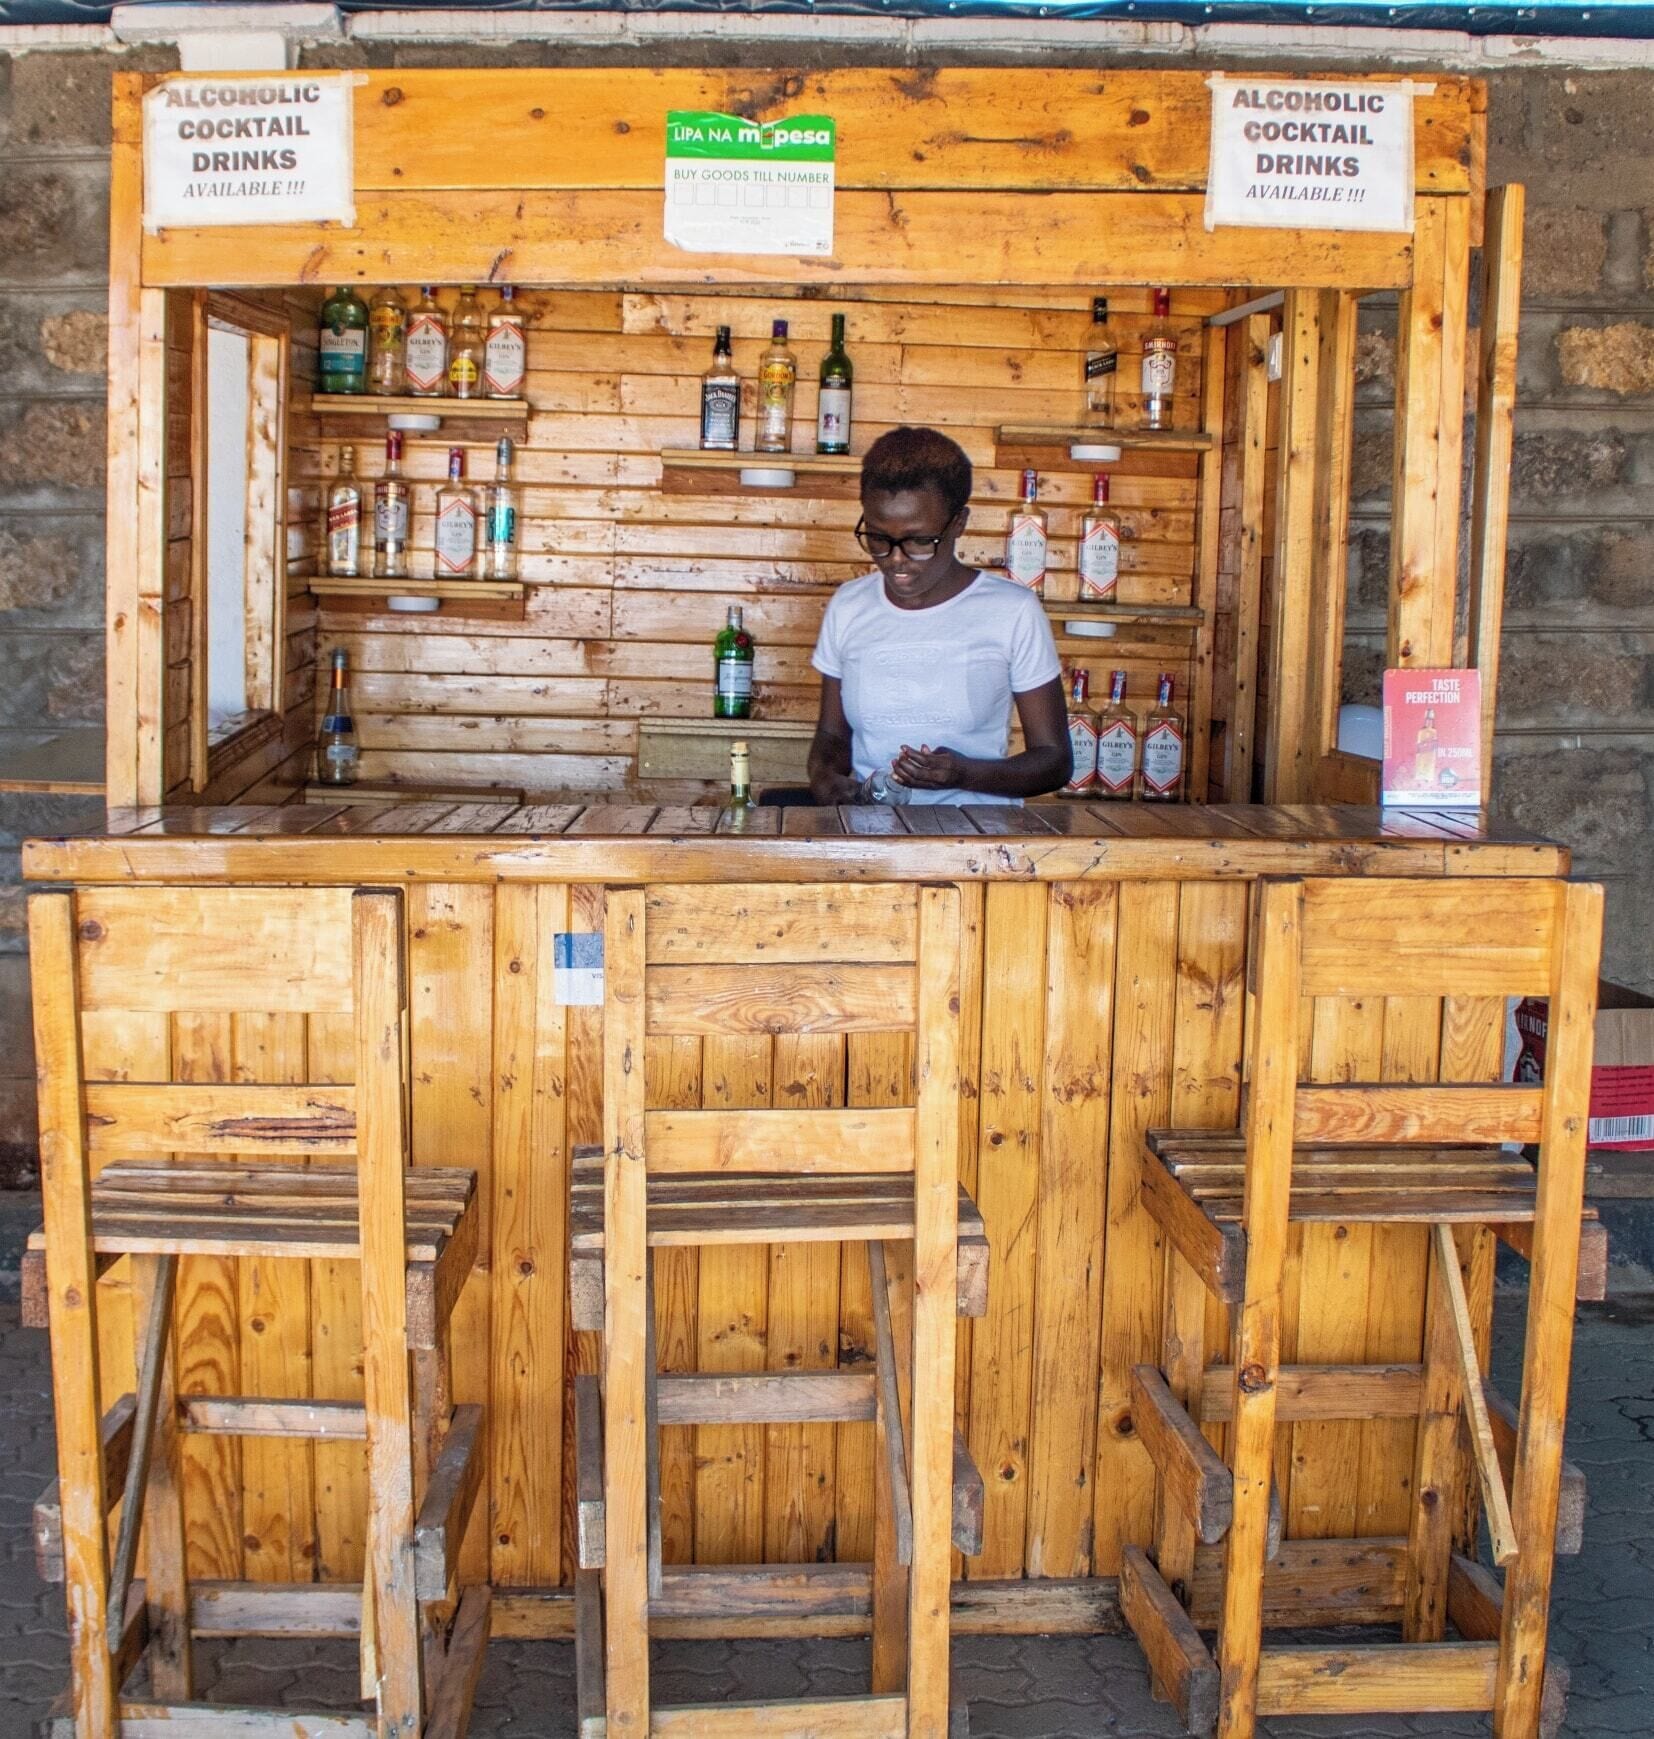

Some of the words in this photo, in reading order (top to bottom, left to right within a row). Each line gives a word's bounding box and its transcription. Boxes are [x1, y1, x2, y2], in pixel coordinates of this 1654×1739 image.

[165, 83, 320, 107] ALCOHOLIC
[1232, 89, 1384, 113] ALCOHOLIC
[178, 115, 310, 139] COCKTAIL
[674, 127, 704, 141] LIPA
[709, 128, 733, 142] NA
[1243, 121, 1373, 145] COCKTAIL
[192, 149, 297, 172] DRINKS
[1256, 154, 1360, 177] DRINKS
[674, 169, 697, 180] BUY
[701, 169, 749, 181] GOODS
[753, 171, 774, 182] TILL
[777, 172, 829, 183] NUMBER
[182, 181, 282, 198] AVAILABLE
[287, 180, 305, 195] !!!
[1246, 184, 1343, 202] AVAILABLE
[1346, 188, 1366, 202] !!!
[1432, 678, 1460, 691] TASTE
[1405, 691, 1461, 704] PERFECTION
